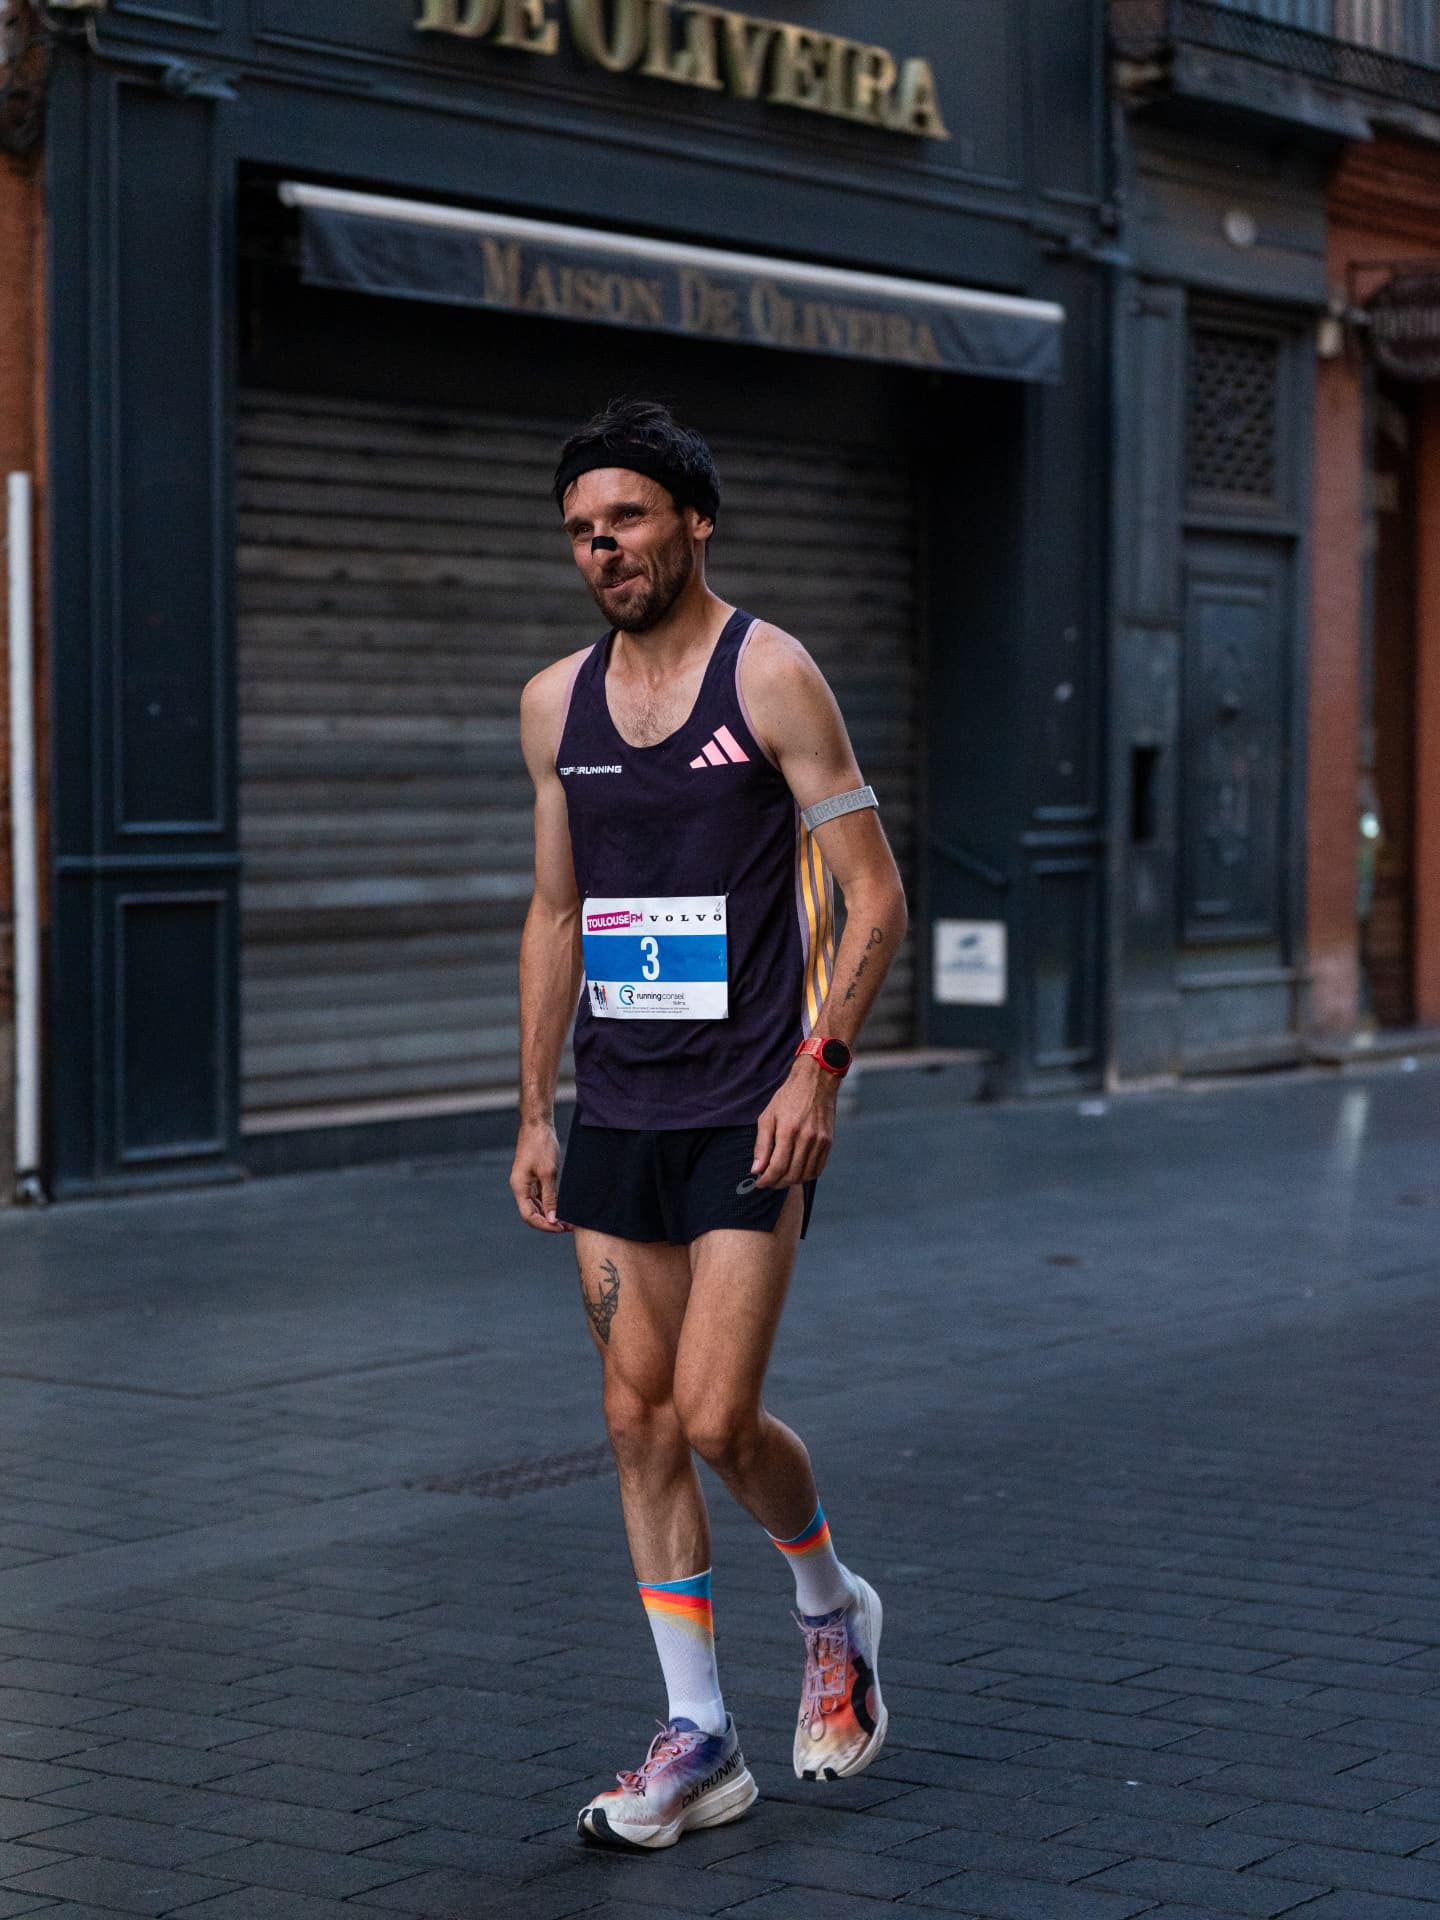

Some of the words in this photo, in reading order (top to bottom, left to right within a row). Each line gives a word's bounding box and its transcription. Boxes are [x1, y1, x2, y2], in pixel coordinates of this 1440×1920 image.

[568, 0, 950, 140] OLIVEIRA
[480, 238, 664, 327] MAISON
[751, 279, 944, 366] OLIVEIRA
[588, 914, 630, 929] TOULOUSE
[649, 914, 722, 922] VOLVO
[640, 936, 660, 981] 3
